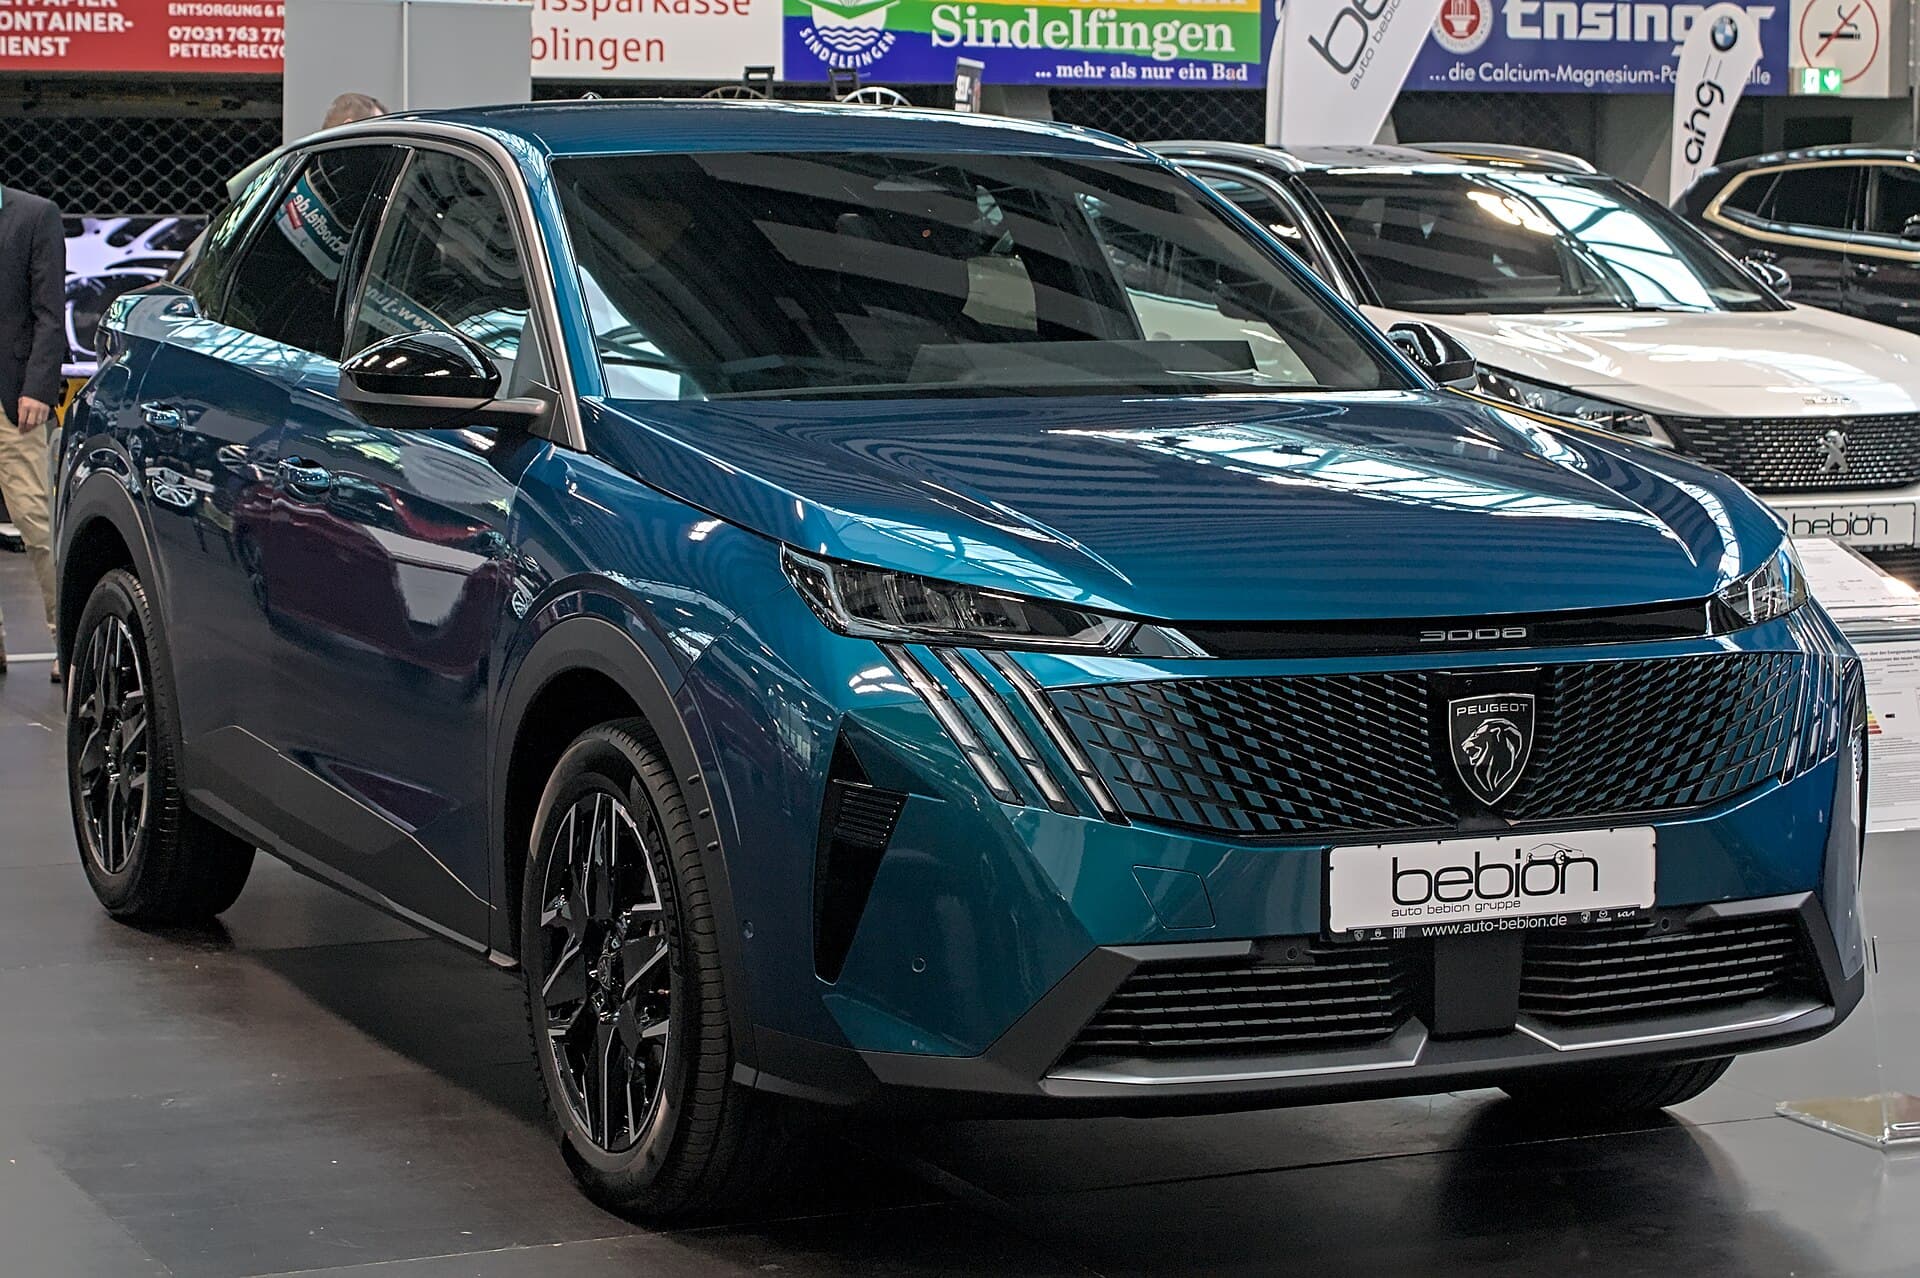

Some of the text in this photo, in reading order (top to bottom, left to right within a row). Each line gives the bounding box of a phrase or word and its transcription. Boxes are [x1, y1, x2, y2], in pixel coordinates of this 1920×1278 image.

[168, 3, 262, 17] ENTSORGUNG
[265, 5, 274, 17] &
[168, 26, 222, 42] 07031
[228, 27, 258, 42] 763
[931, 4, 1235, 61] Sindelfingen
[799, 27, 896, 68] SINDELFINGEN
[1056, 62, 1106, 79] mehr
[1110, 62, 1136, 80] als
[1141, 64, 1175, 80] nur
[1178, 63, 1207, 80] ein
[1212, 64, 1248, 81] Bad
[1350, 48, 1375, 90] auto
[1684, 79, 1725, 165] ahg
[1420, 627, 1527, 642] 3008
[1456, 703, 1528, 717] PEUGEOT
[1392, 848, 1599, 906] bebion
[1391, 899, 1521, 918] auto bebion gruppe
[1421, 914, 1568, 937] www.auto-bebion.de
